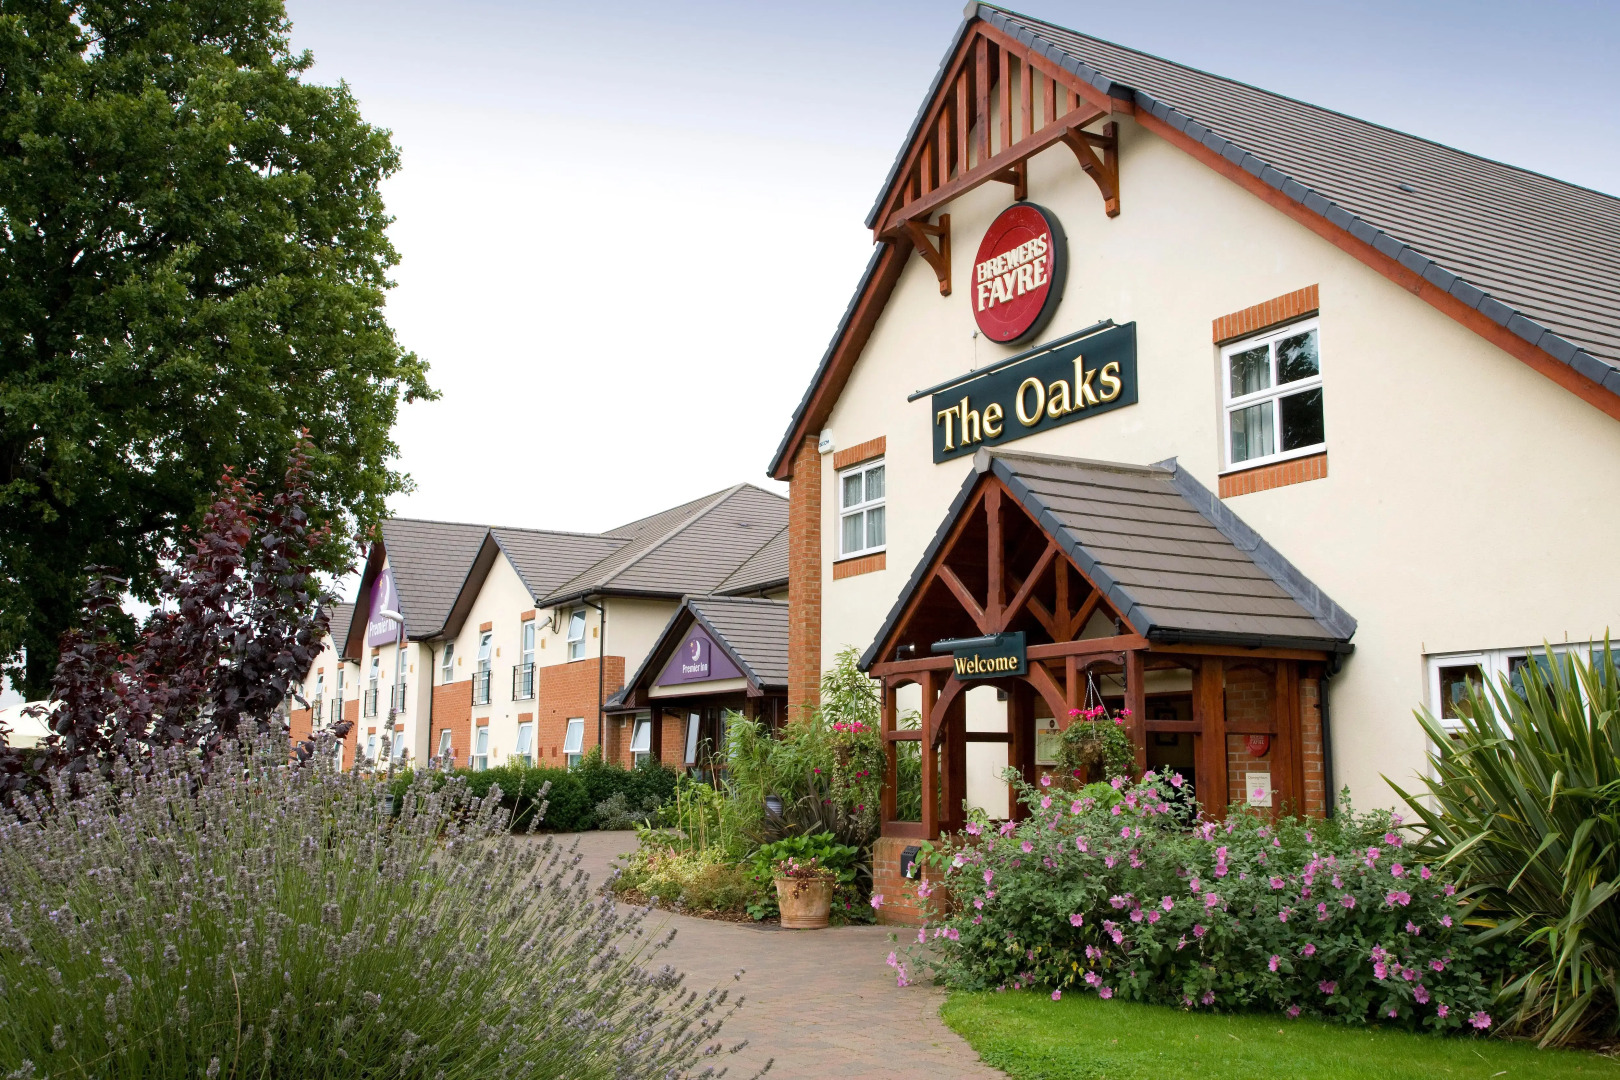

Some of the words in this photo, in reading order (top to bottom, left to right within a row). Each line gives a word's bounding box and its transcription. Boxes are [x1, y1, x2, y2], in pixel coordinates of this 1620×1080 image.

[976, 232, 1047, 283] BREWERS
[976, 255, 1047, 312] FAYRE
[937, 395, 1003, 452] The
[1015, 354, 1122, 427] Oaks
[368, 617, 388, 638] Premier
[682, 663, 700, 674] Premier
[700, 662, 708, 671] Inn
[954, 653, 1018, 675] Welcome
